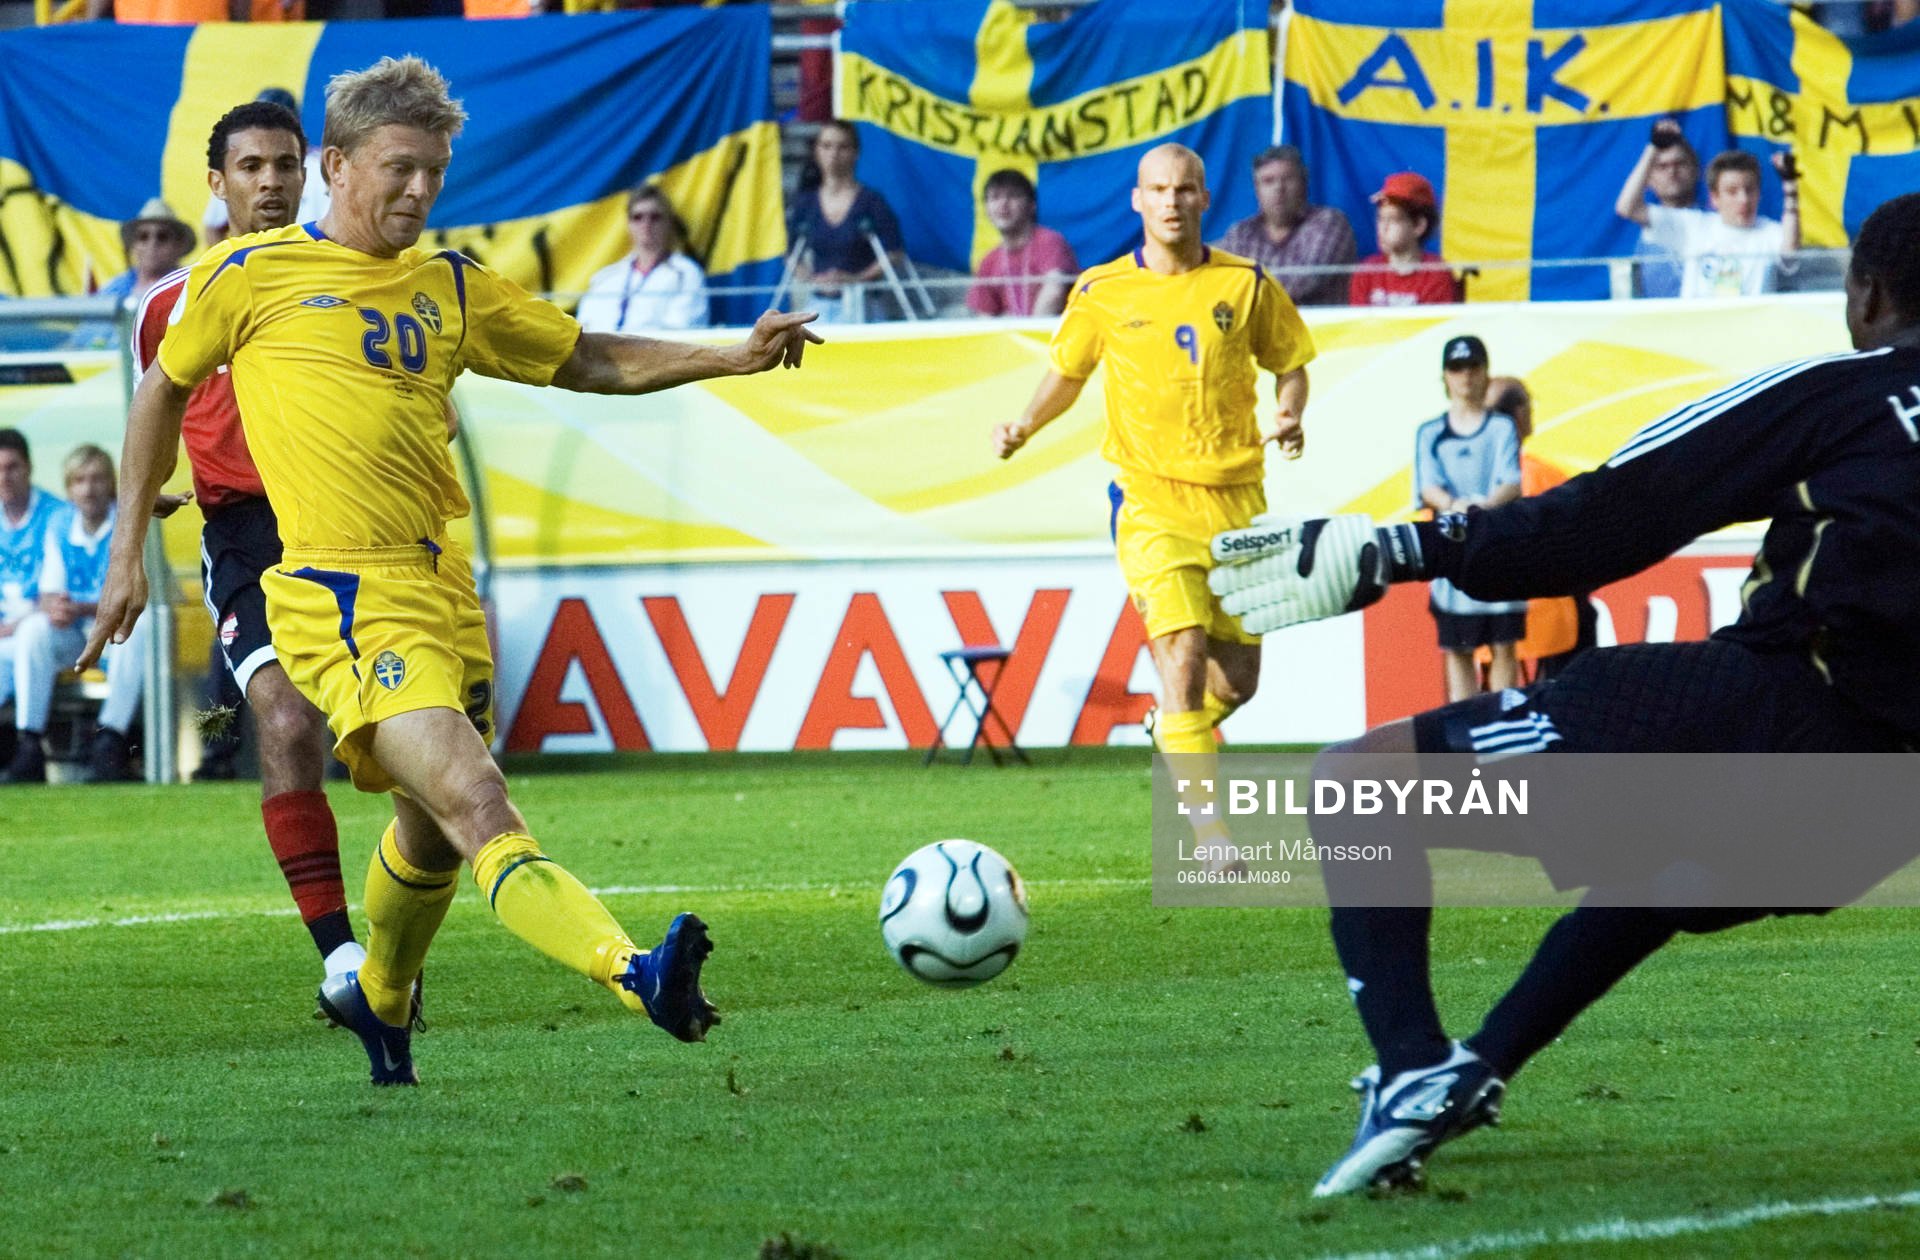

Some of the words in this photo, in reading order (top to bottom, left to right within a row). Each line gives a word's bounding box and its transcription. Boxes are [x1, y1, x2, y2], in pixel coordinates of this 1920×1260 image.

[1336, 30, 1609, 114] A.I.K.
[856, 63, 1207, 156] KRISTIANSTAD
[356, 306, 427, 375] 20
[1174, 324, 1198, 365] 9
[1221, 528, 1291, 552] Selsport
